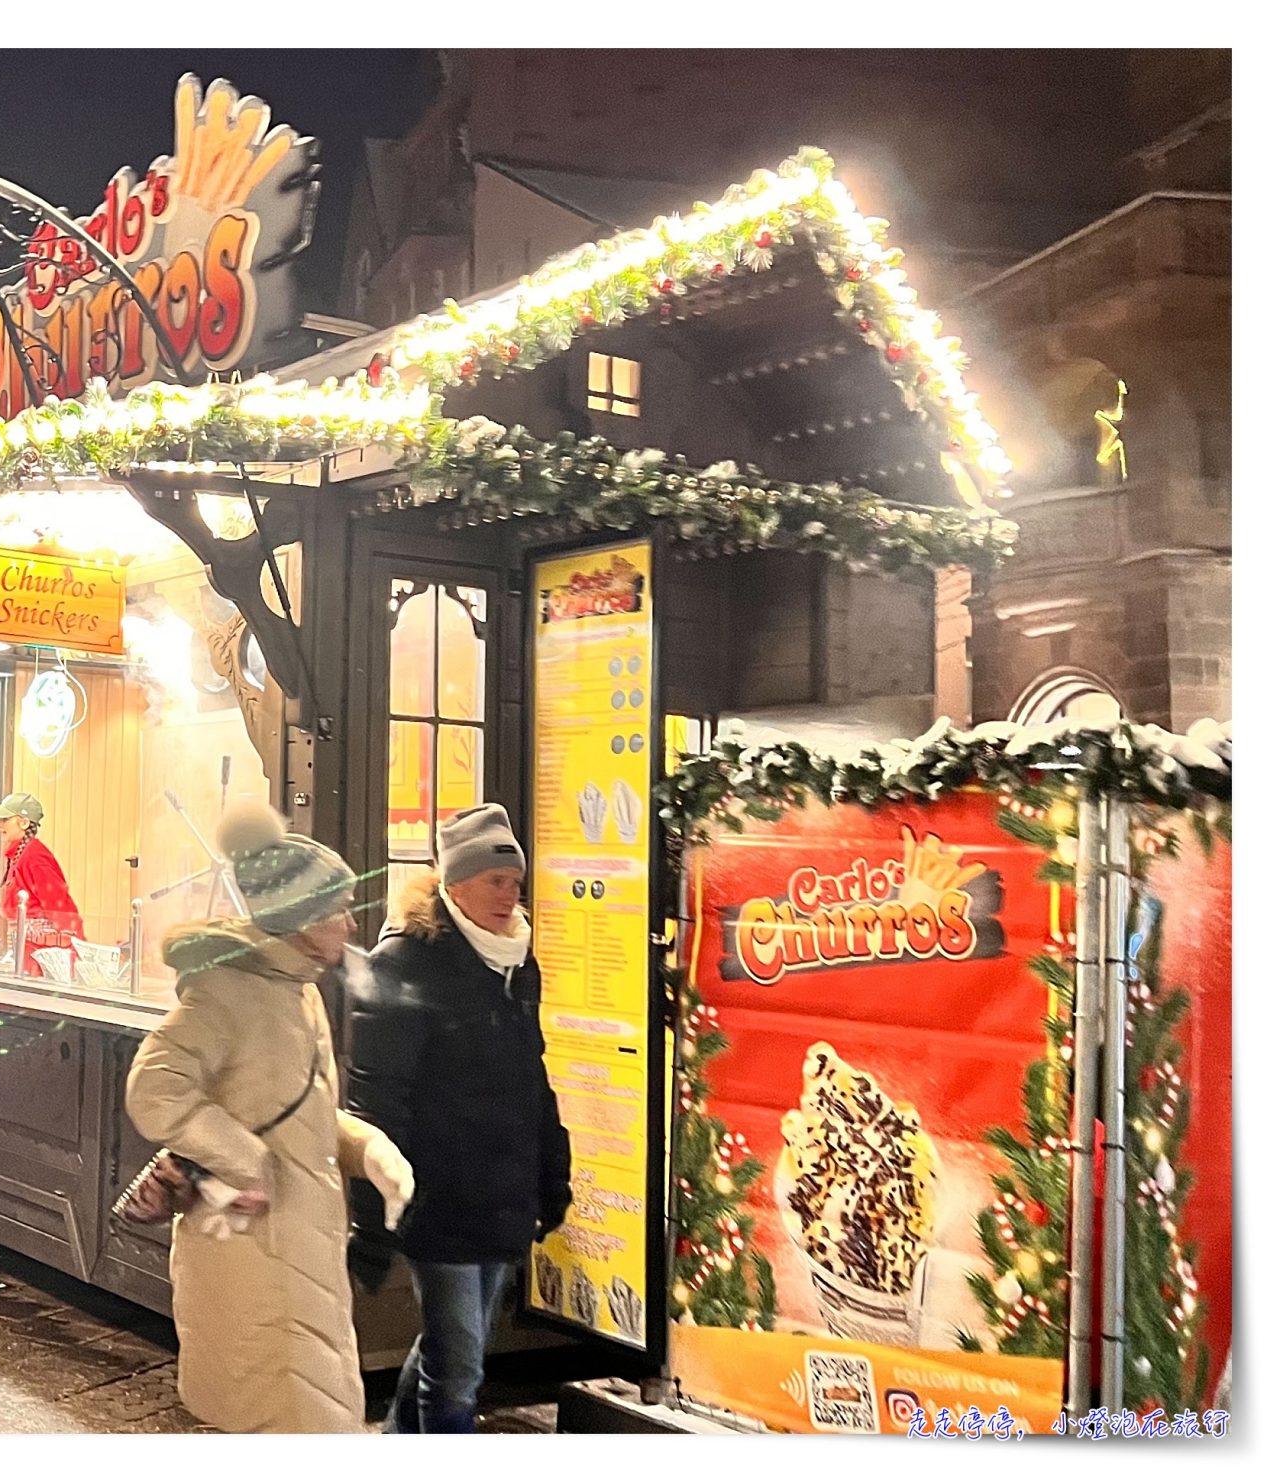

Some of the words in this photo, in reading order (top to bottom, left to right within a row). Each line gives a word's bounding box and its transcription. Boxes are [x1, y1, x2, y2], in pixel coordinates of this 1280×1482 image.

[1, 566, 97, 600] Churros
[790, 858, 906, 913] Carlo's
[738, 891, 974, 980] Churros
[893, 1366, 961, 1390] FOLLOW
[962, 1372, 987, 1394] US
[989, 1377, 1021, 1397] ON
